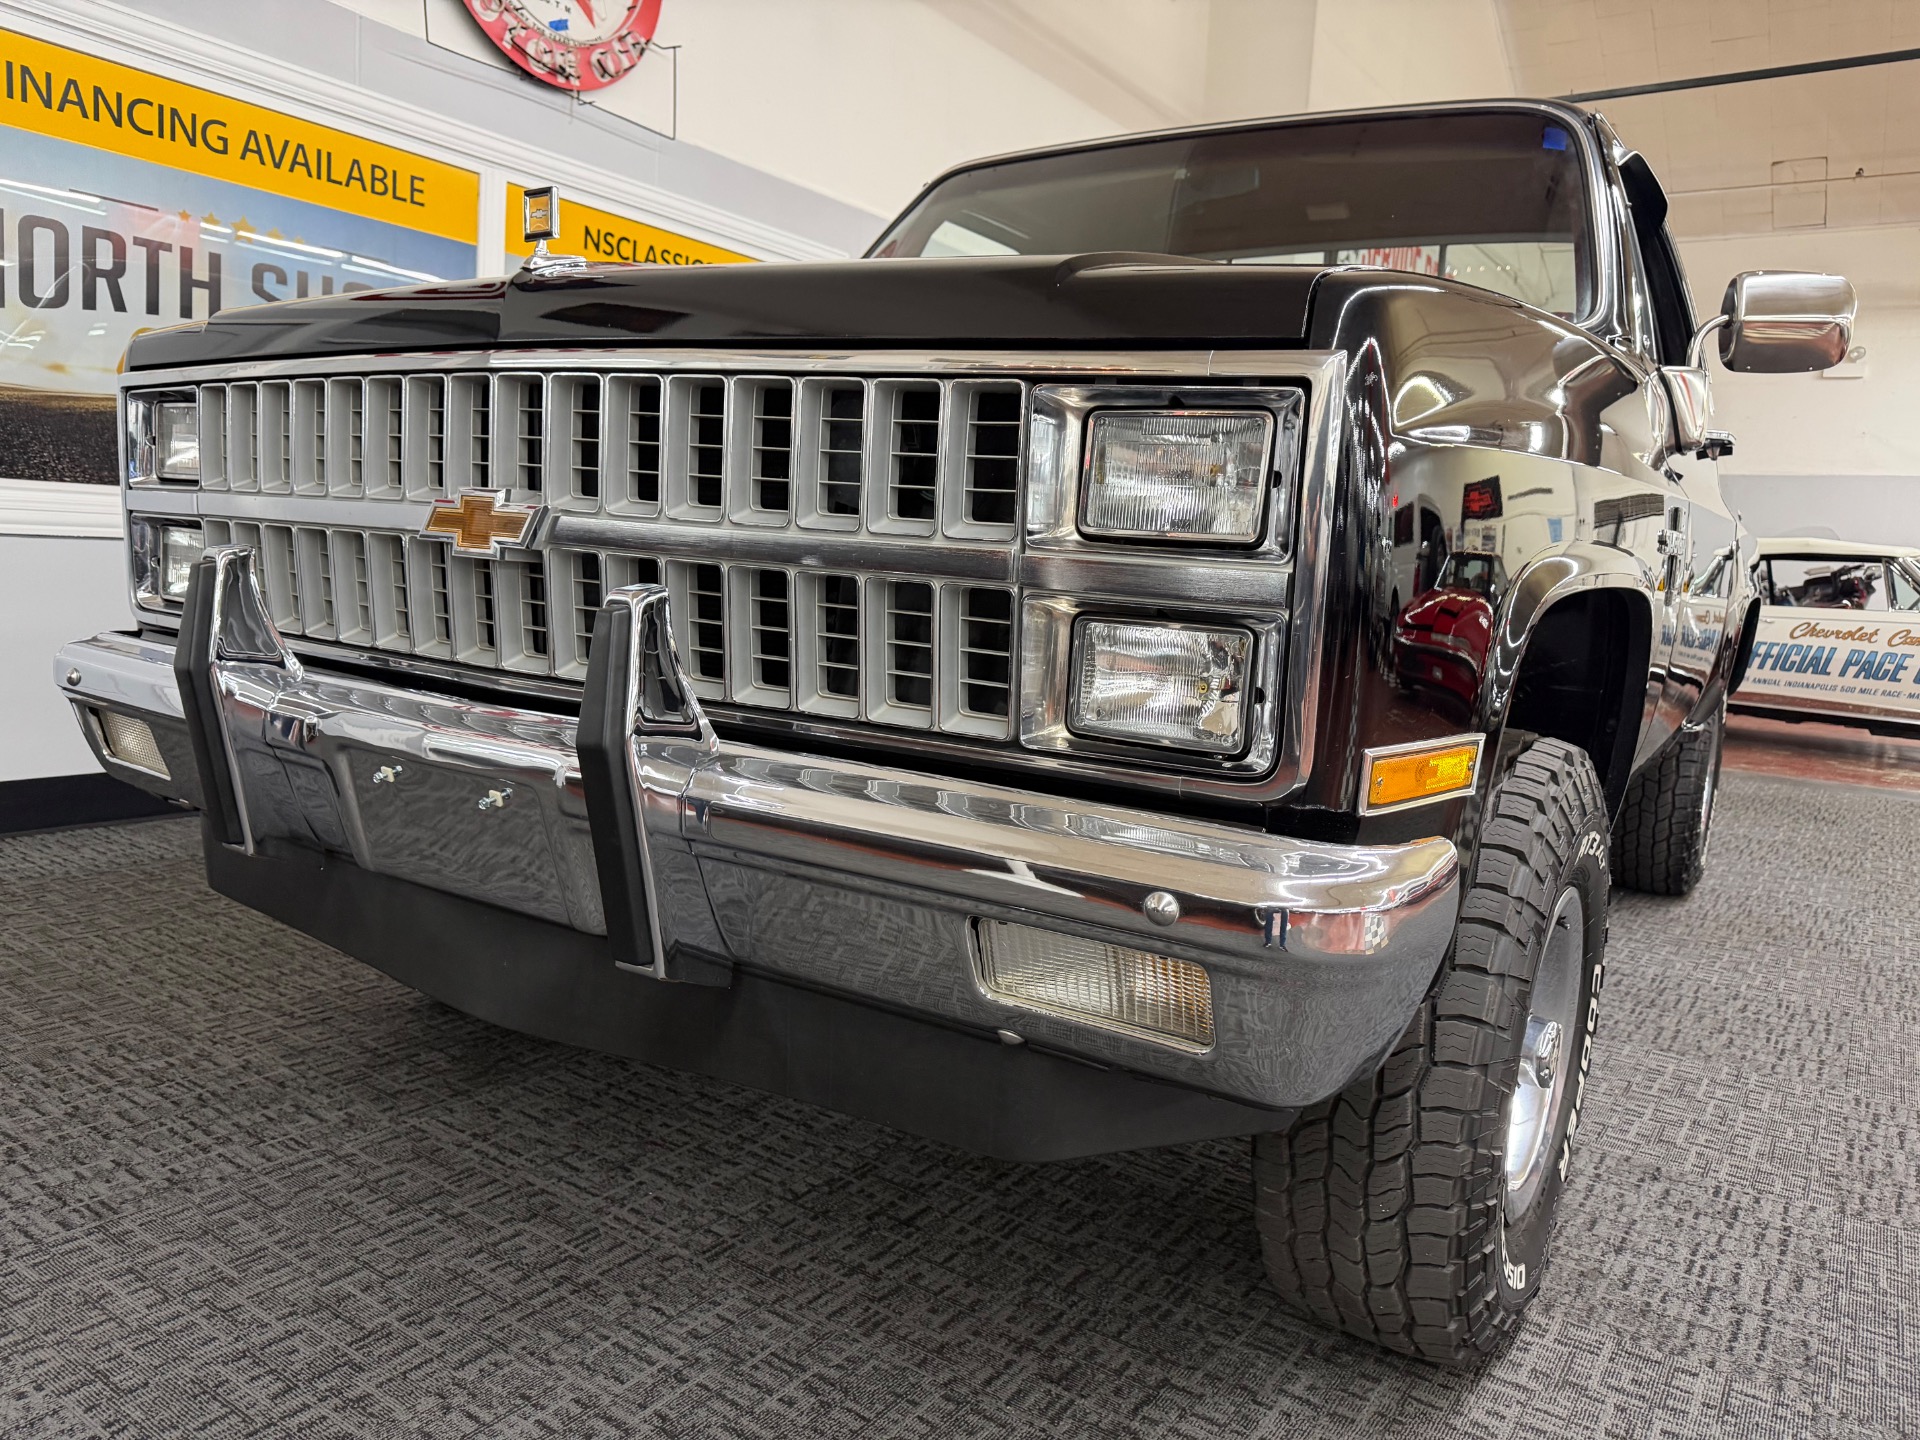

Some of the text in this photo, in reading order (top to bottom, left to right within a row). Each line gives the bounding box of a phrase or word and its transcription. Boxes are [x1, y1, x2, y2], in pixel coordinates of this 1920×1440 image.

[6, 60, 425, 207] INANCING AVAILABLE
[0, 207, 222, 319] ORTH
[584, 225, 713, 265] NSCLASS
[1789, 621, 1881, 644] Chevrolet
[1838, 648, 1915, 684] PACE
[1750, 678, 1782, 687] ANNUAL
[1783, 680, 1838, 691] INDIANAPOLIS
[1840, 685, 1856, 693] 500
[1858, 688, 1878, 696] MILE
[1559, 964, 1603, 1183] COOPER
